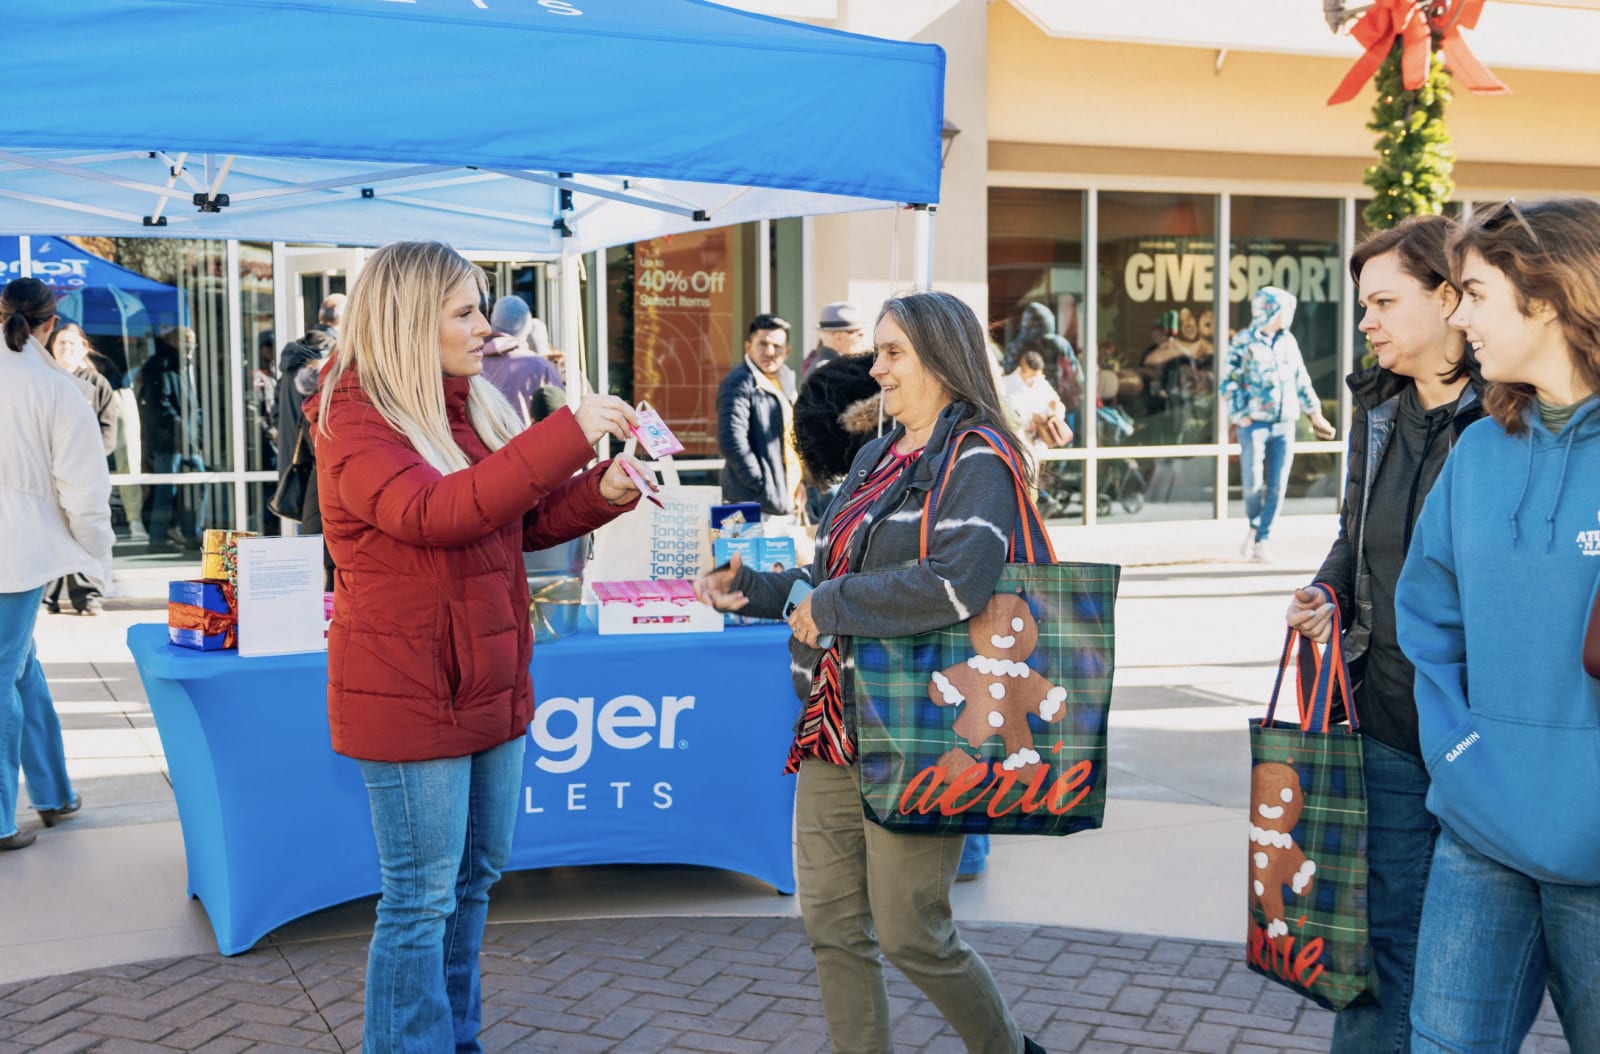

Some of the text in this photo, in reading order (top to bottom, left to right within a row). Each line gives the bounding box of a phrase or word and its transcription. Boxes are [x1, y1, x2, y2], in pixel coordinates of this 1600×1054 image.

[639, 269, 725, 293] 40% Off
[1124, 253, 1340, 303] GIVE SPORT
[640, 294, 711, 307] Select Items
[651, 511, 699, 529] Tanger
[650, 525, 700, 542] Tanger
[650, 537, 700, 554] Tanger
[650, 550, 700, 567] Tanger
[649, 562, 700, 579] Tanger
[524, 694, 696, 774] ger
[1445, 731, 1481, 762] GARMIN
[899, 740, 1093, 818] aerie
[1247, 914, 1324, 989] erie
